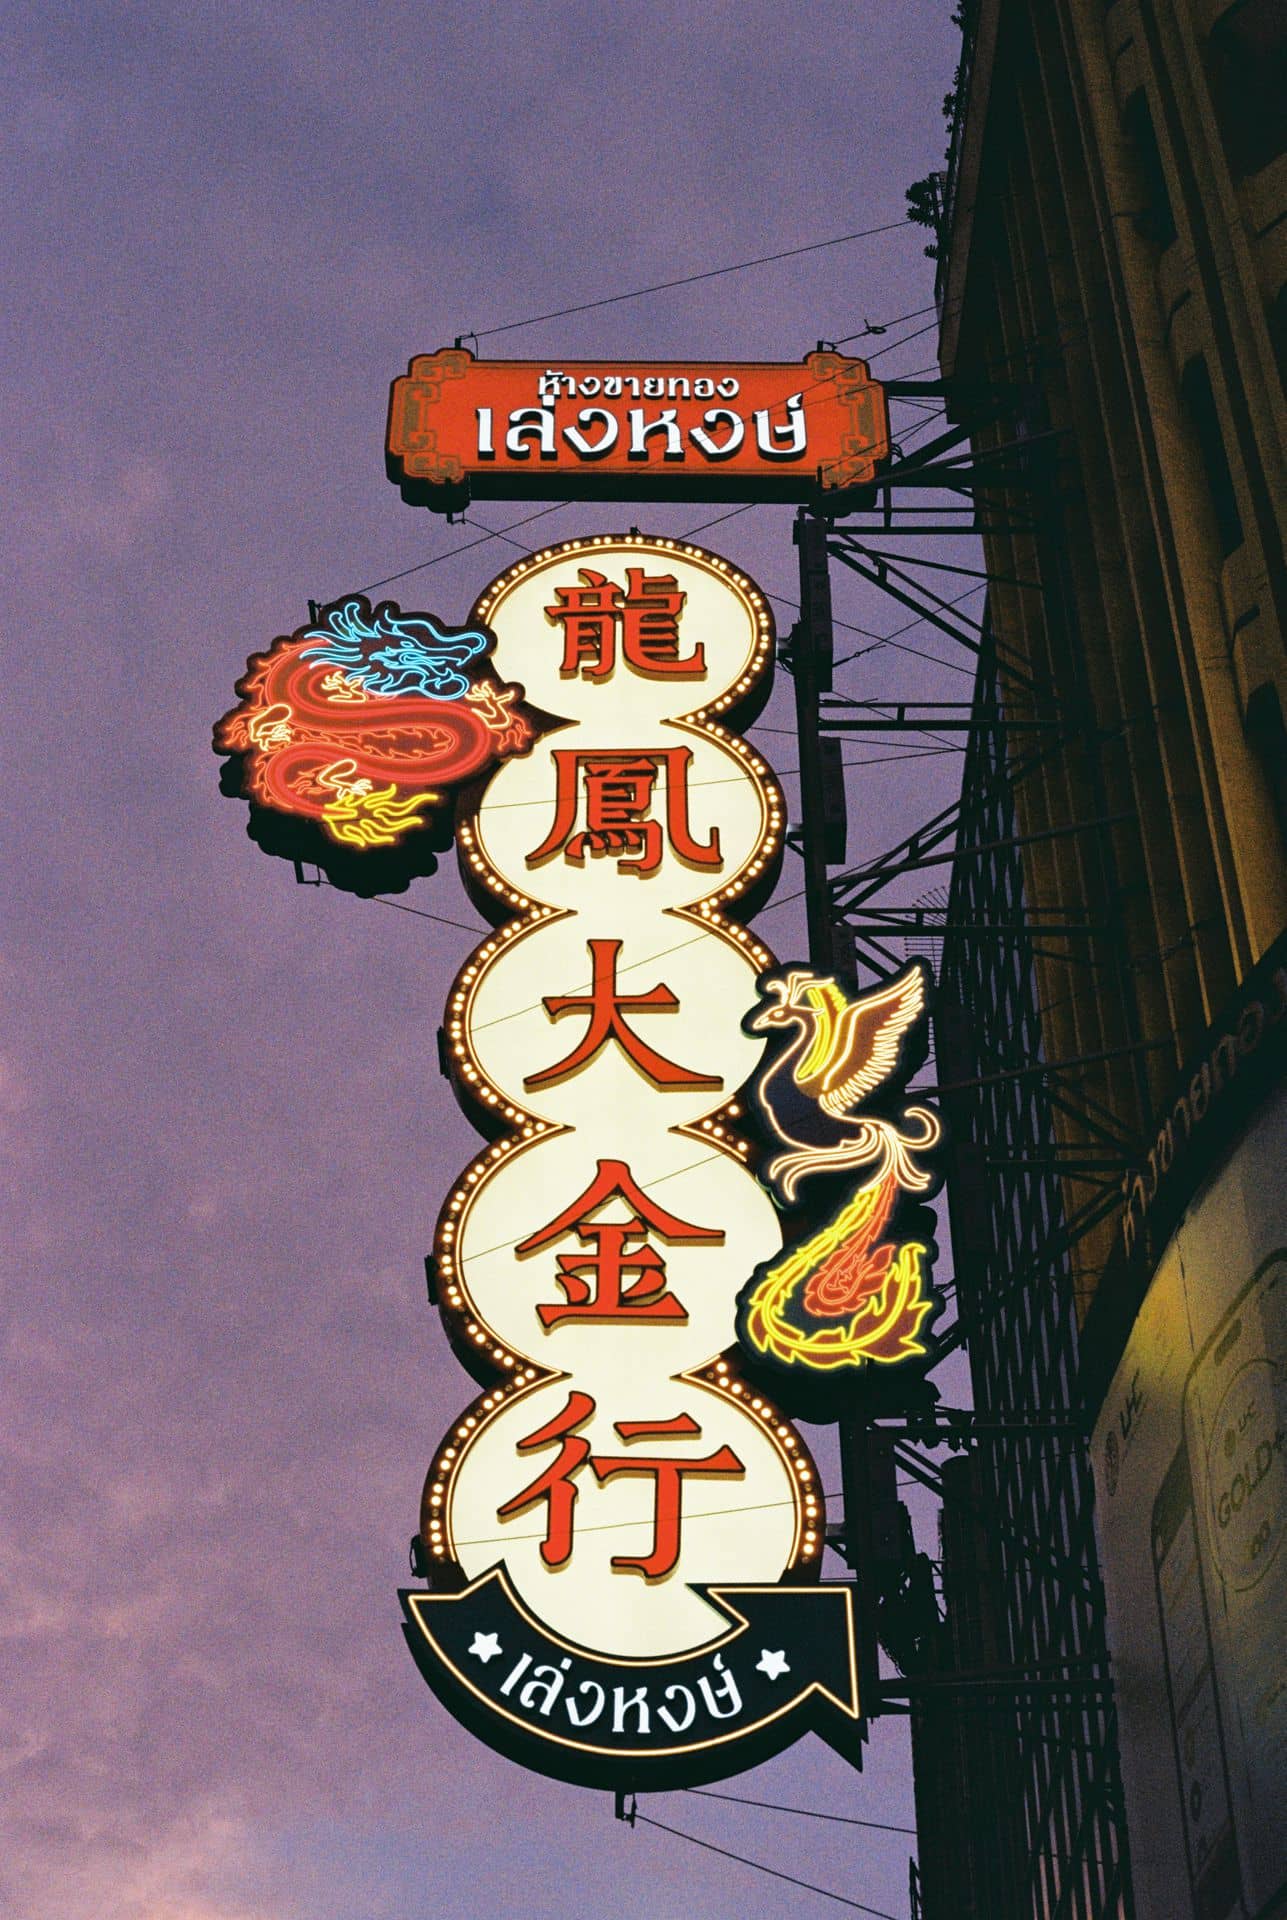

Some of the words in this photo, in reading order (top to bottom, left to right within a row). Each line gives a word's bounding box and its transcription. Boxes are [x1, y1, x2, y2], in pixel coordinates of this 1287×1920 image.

[538, 369, 740, 398] ห้างขายทอง
[475, 393, 808, 454] เล่งหงษ์
[496, 568, 746, 1583] 龍鳳大金行
[500, 1651, 743, 1734] เล่งหงษ์
